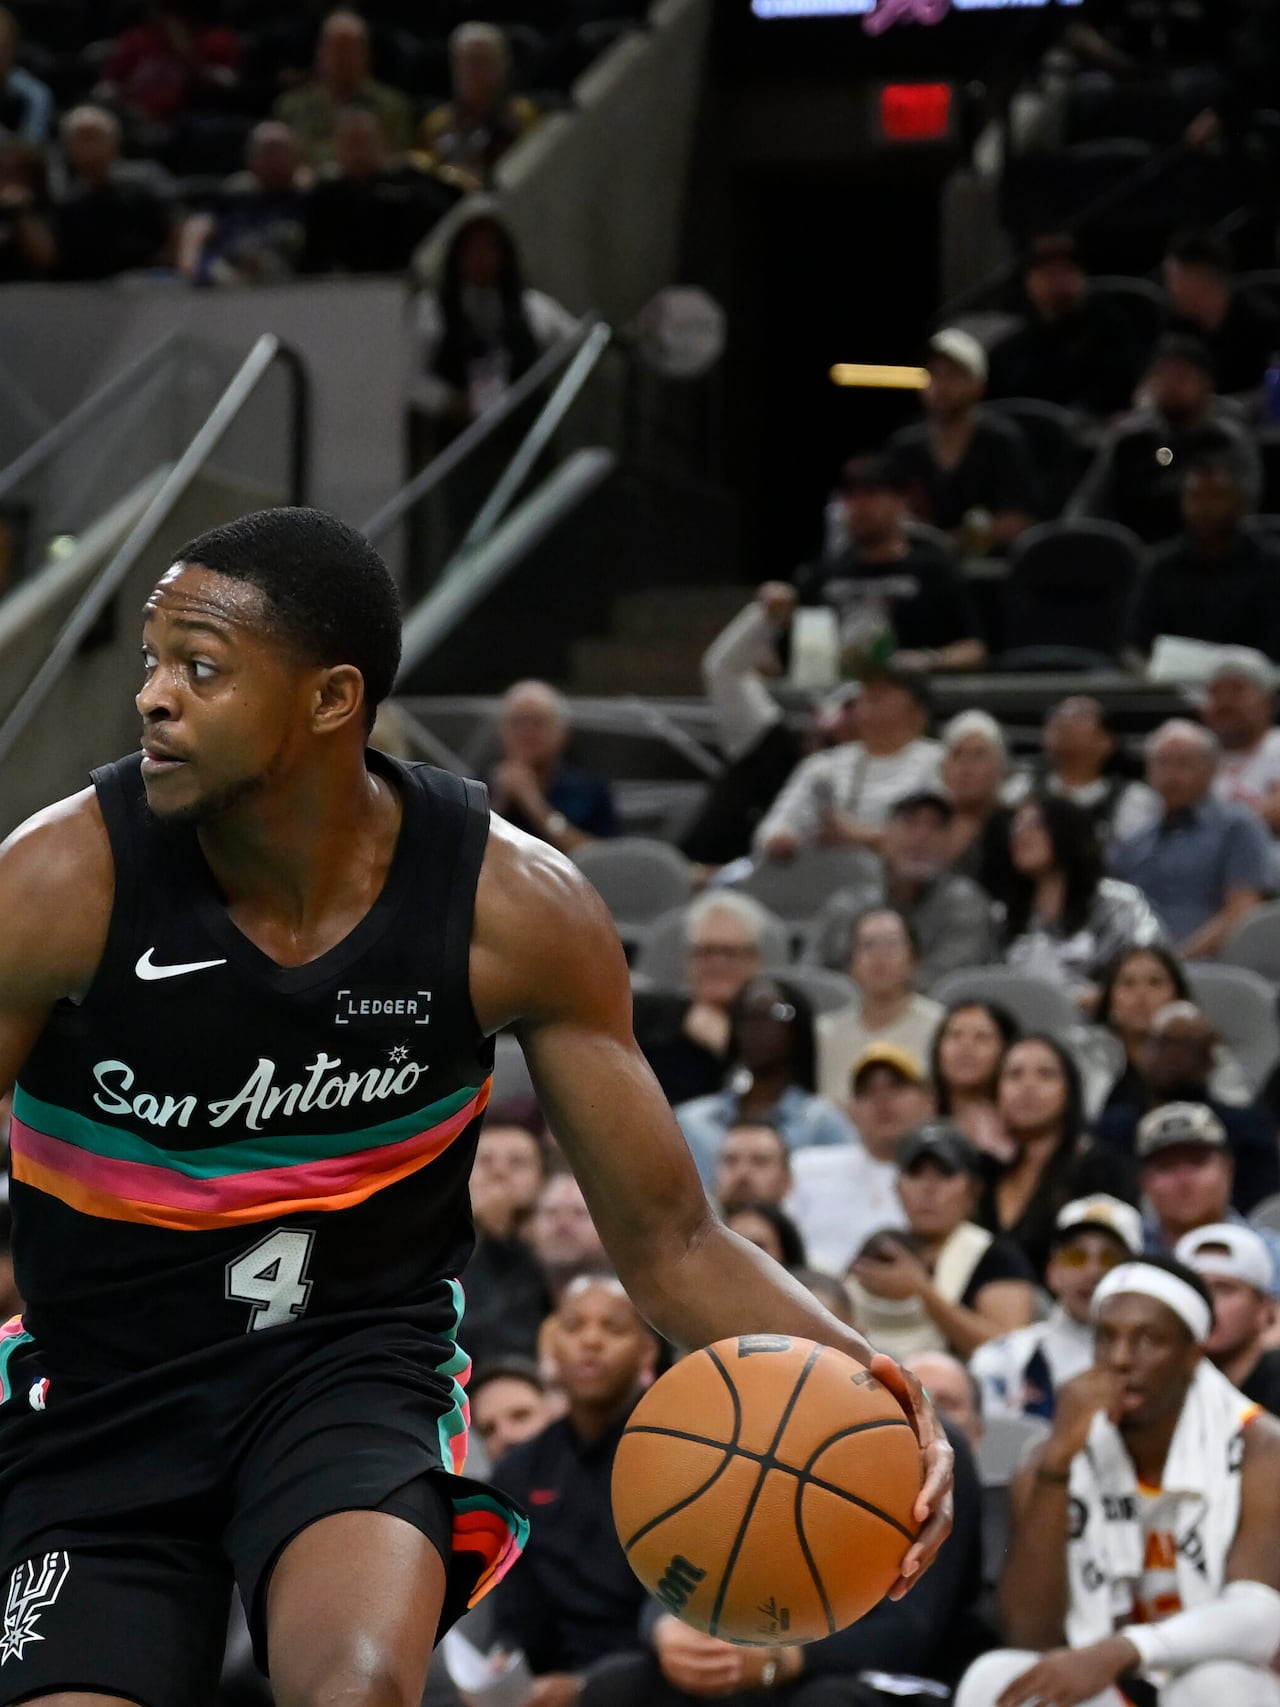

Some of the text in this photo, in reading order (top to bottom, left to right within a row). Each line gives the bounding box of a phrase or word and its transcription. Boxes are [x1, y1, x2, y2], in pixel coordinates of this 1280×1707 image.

[348, 1000, 418, 1015] LEDGER
[93, 1046, 429, 1130] San Antonio
[225, 1227, 316, 1334] 4
[658, 1554, 707, 1613] on
